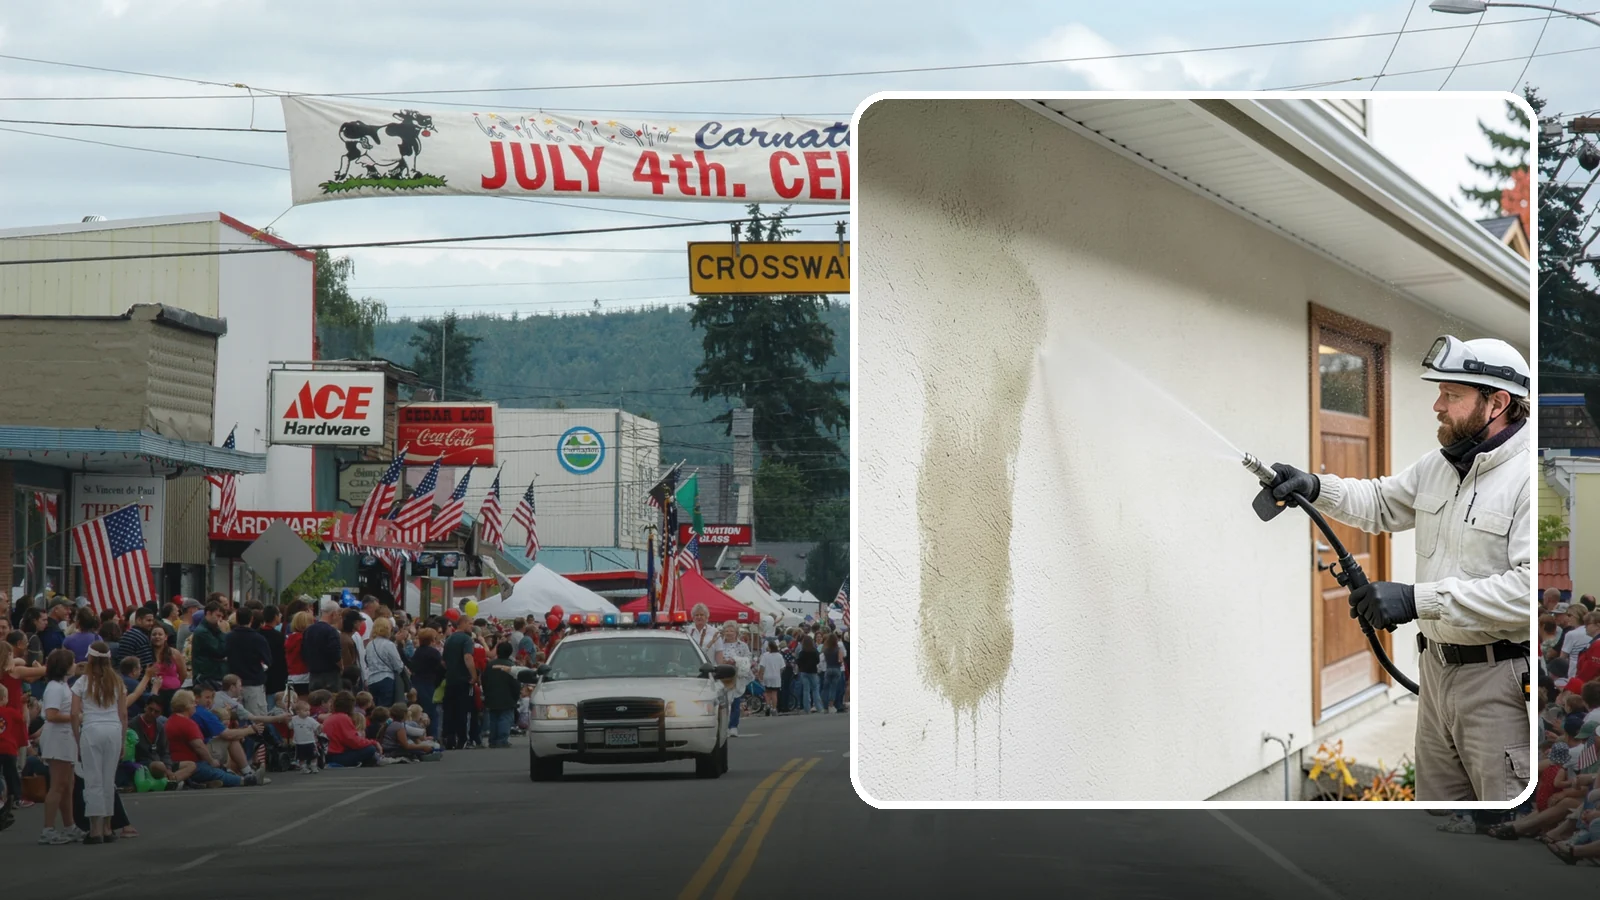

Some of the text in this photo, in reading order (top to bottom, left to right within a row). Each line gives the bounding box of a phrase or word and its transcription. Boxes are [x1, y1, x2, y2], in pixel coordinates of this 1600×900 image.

[481, 141, 605, 193] JULY
[632, 150, 746, 198] 4th.
[697, 254, 850, 280] CROSSWA
[282, 379, 374, 420] ACE
[406, 409, 452, 422] CEDAR
[283, 421, 371, 437] Hardware
[83, 484, 155, 495] St. Vincent de Paul
[699, 535, 730, 543] GLASS
